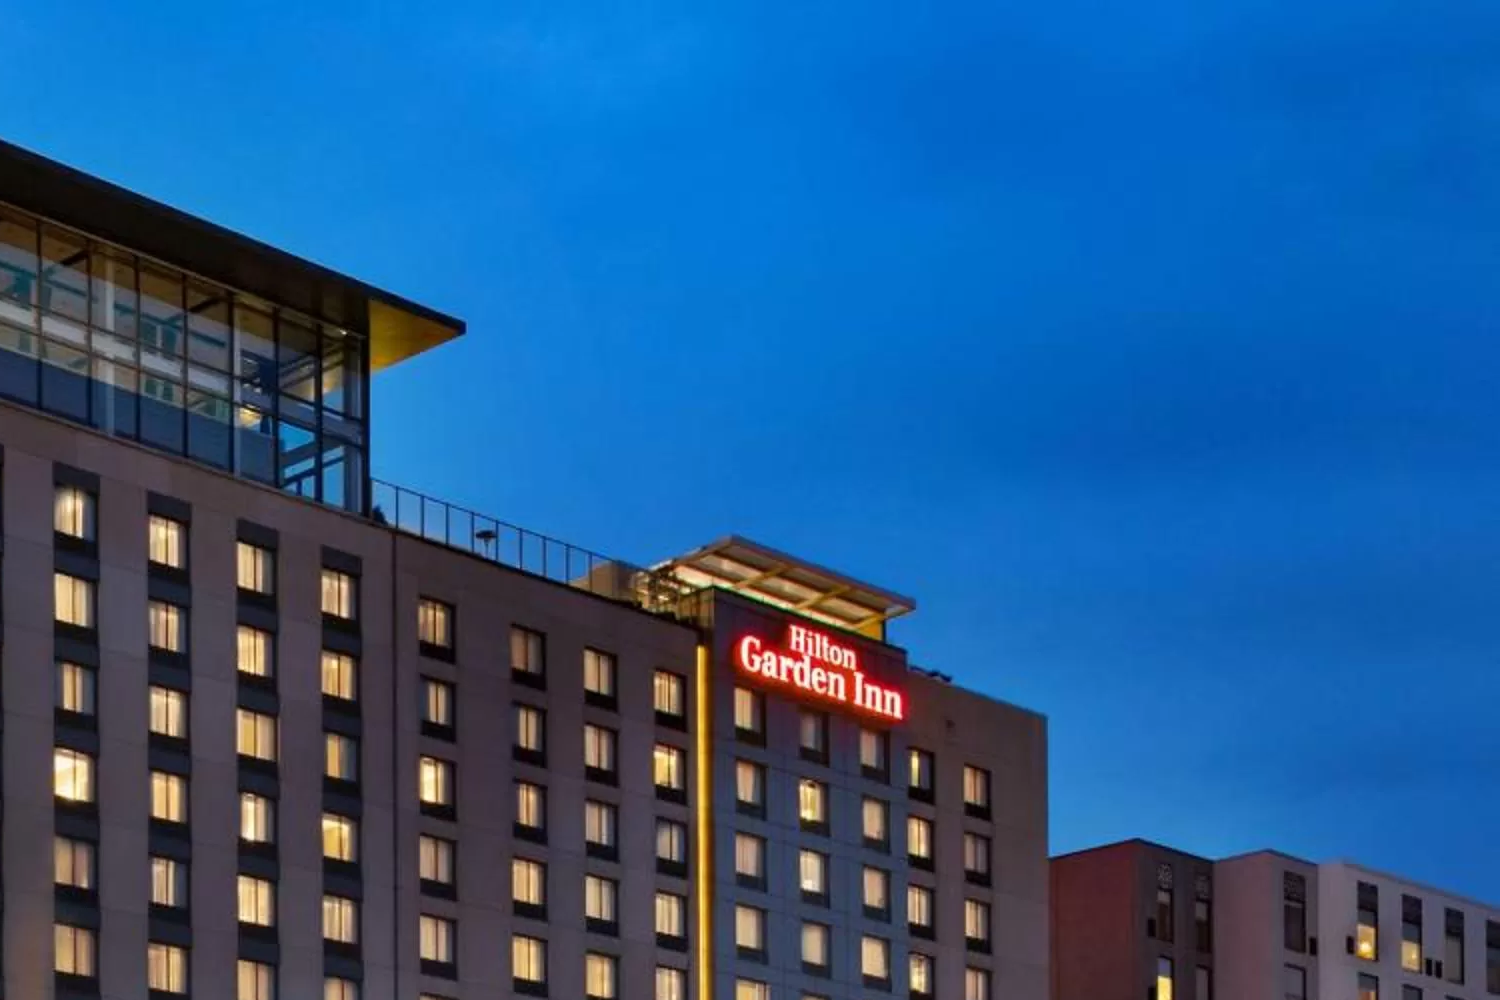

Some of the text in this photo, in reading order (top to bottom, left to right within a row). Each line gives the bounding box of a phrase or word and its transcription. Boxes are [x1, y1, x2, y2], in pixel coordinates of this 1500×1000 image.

[740, 635, 903, 720] Garden Inn
[789, 624, 857, 670] Hilton
